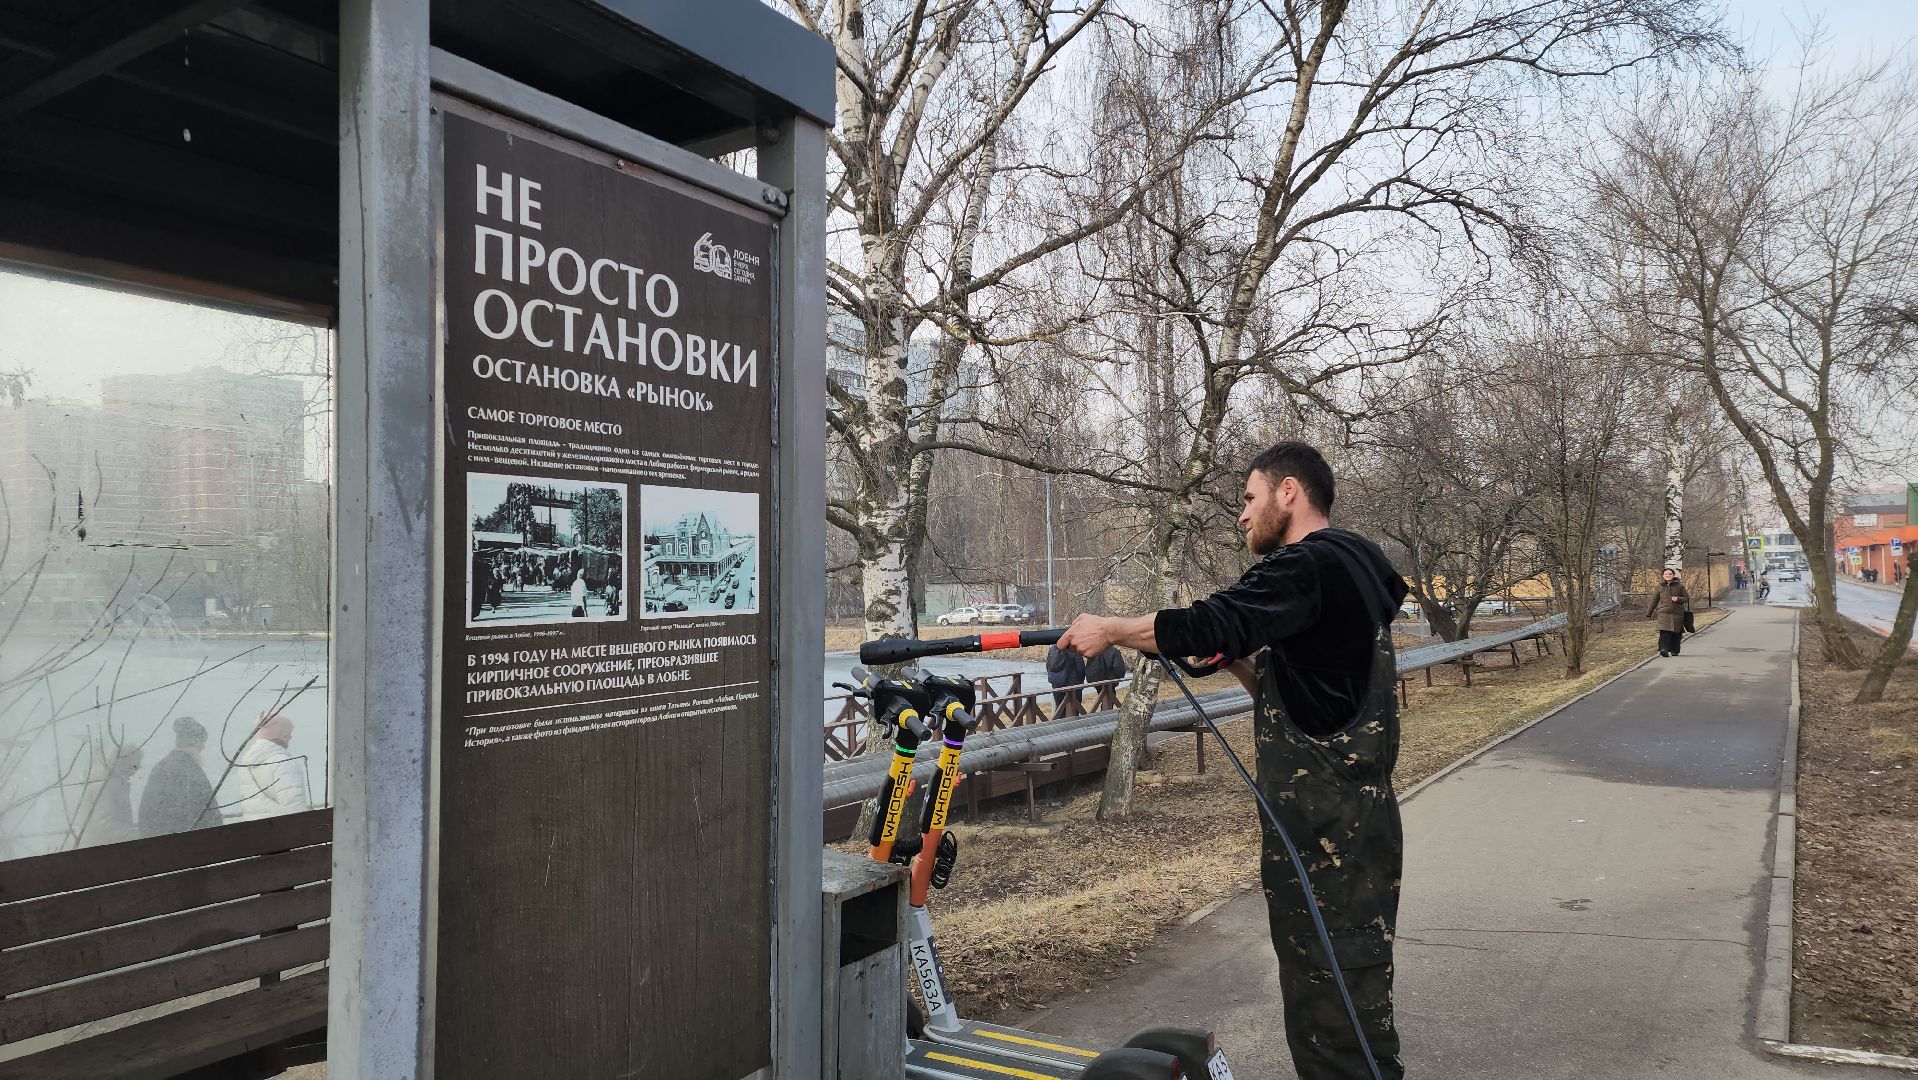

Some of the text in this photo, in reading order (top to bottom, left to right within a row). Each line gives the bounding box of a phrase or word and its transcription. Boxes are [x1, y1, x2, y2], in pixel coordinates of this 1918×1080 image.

[476, 163, 542, 231] НЕ
[474, 224, 679, 318] ПРОСТО
[473, 289, 758, 388] ОСТАНОВКИ
[472, 354, 714, 412] ОСТАНОВКА «РЫНОК»
[467, 406, 622, 435] САМОЕ ТОРГОВОЕ МЕСТО
[467, 429, 526, 444] Привокзальная
[528, 438, 560, 448] площадь
[567, 442, 612, 453] традиционно
[613, 447, 630, 455] одно
[641, 450, 660, 458] самых
[467, 441, 509, 453] Несколько
[509, 447, 556, 458] десятилетий
[556, 452, 561, 460] у
[562, 452, 624, 464] железнодорожного
[625, 458, 644, 466] моста
[689, 463, 723, 474] фермерский
[473, 455, 490, 463] ним
[494, 456, 529, 466] вещевой.
[530, 458, 564, 469] Название
[564, 463, 599, 472] остановки
[602, 466, 644, 475] напоминание
[467, 634, 757, 666] В 1994 ГОДУ НА МЕСТЕ ВЕЩЕВОГО РЫНКА ПОЯВИЛОСЬ
[467, 652, 719, 685] КИРПИЧНОЕ СООРУЖЕНИЕ, ПРЕОБРАЗИВШЕЕ
[466, 680, 584, 703] ПРИВОКЗАЛЬНУЮ
[586, 675, 645, 691] ПЛОЩАДЬ
[647, 674, 654, 685] В
[488, 722, 532, 733] подготовке
[533, 718, 553, 728] были
[554, 712, 603, 725] использованы
[604, 709, 639, 718] материалы
[511, 732, 533, 742] также
[533, 729, 553, 740] фото
[562, 725, 591, 735] фондов
[883, 761, 911, 838] WHOOSH
[932, 753, 958, 826] WHOOSH
